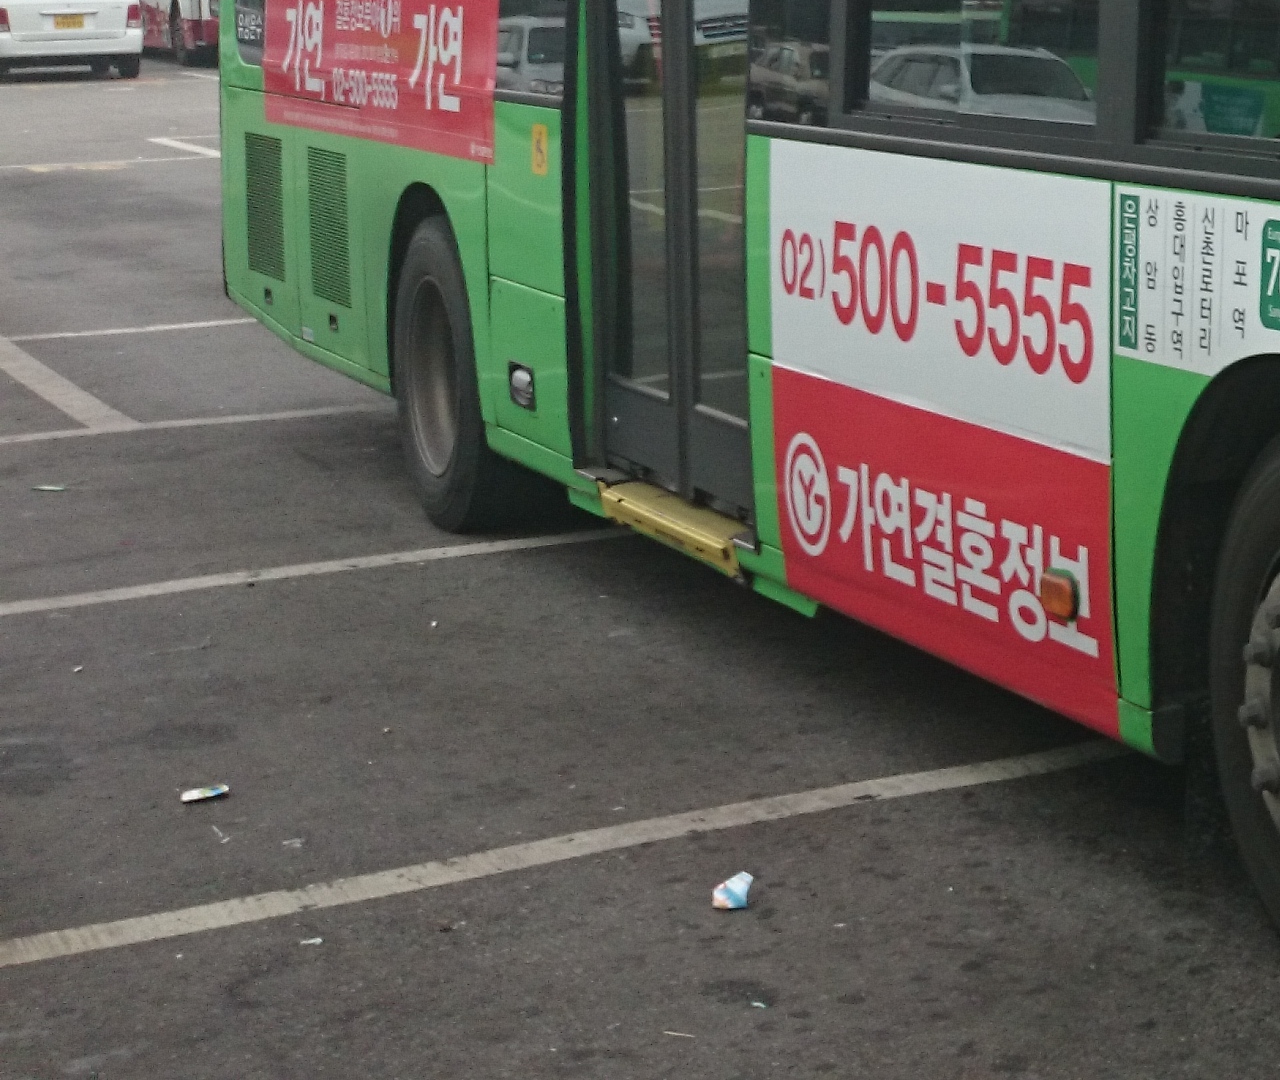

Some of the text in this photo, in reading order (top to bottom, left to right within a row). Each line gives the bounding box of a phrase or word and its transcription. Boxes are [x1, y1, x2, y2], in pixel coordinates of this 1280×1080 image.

[332, 67, 399, 110] 02-500-5555
[408, 4, 469, 113] 가연
[780, 219, 1095, 385] 02)500-5555
[1122, 200, 1137, 344] 은평차고지
[1143, 198, 1159, 354] 상암동
[1170, 201, 1187, 360] 홍대입구역
[1199, 206, 1215, 357] 신촌로터리
[1232, 210, 1250, 339] 마포역
[837, 462, 1100, 659] 가연결혼정보
